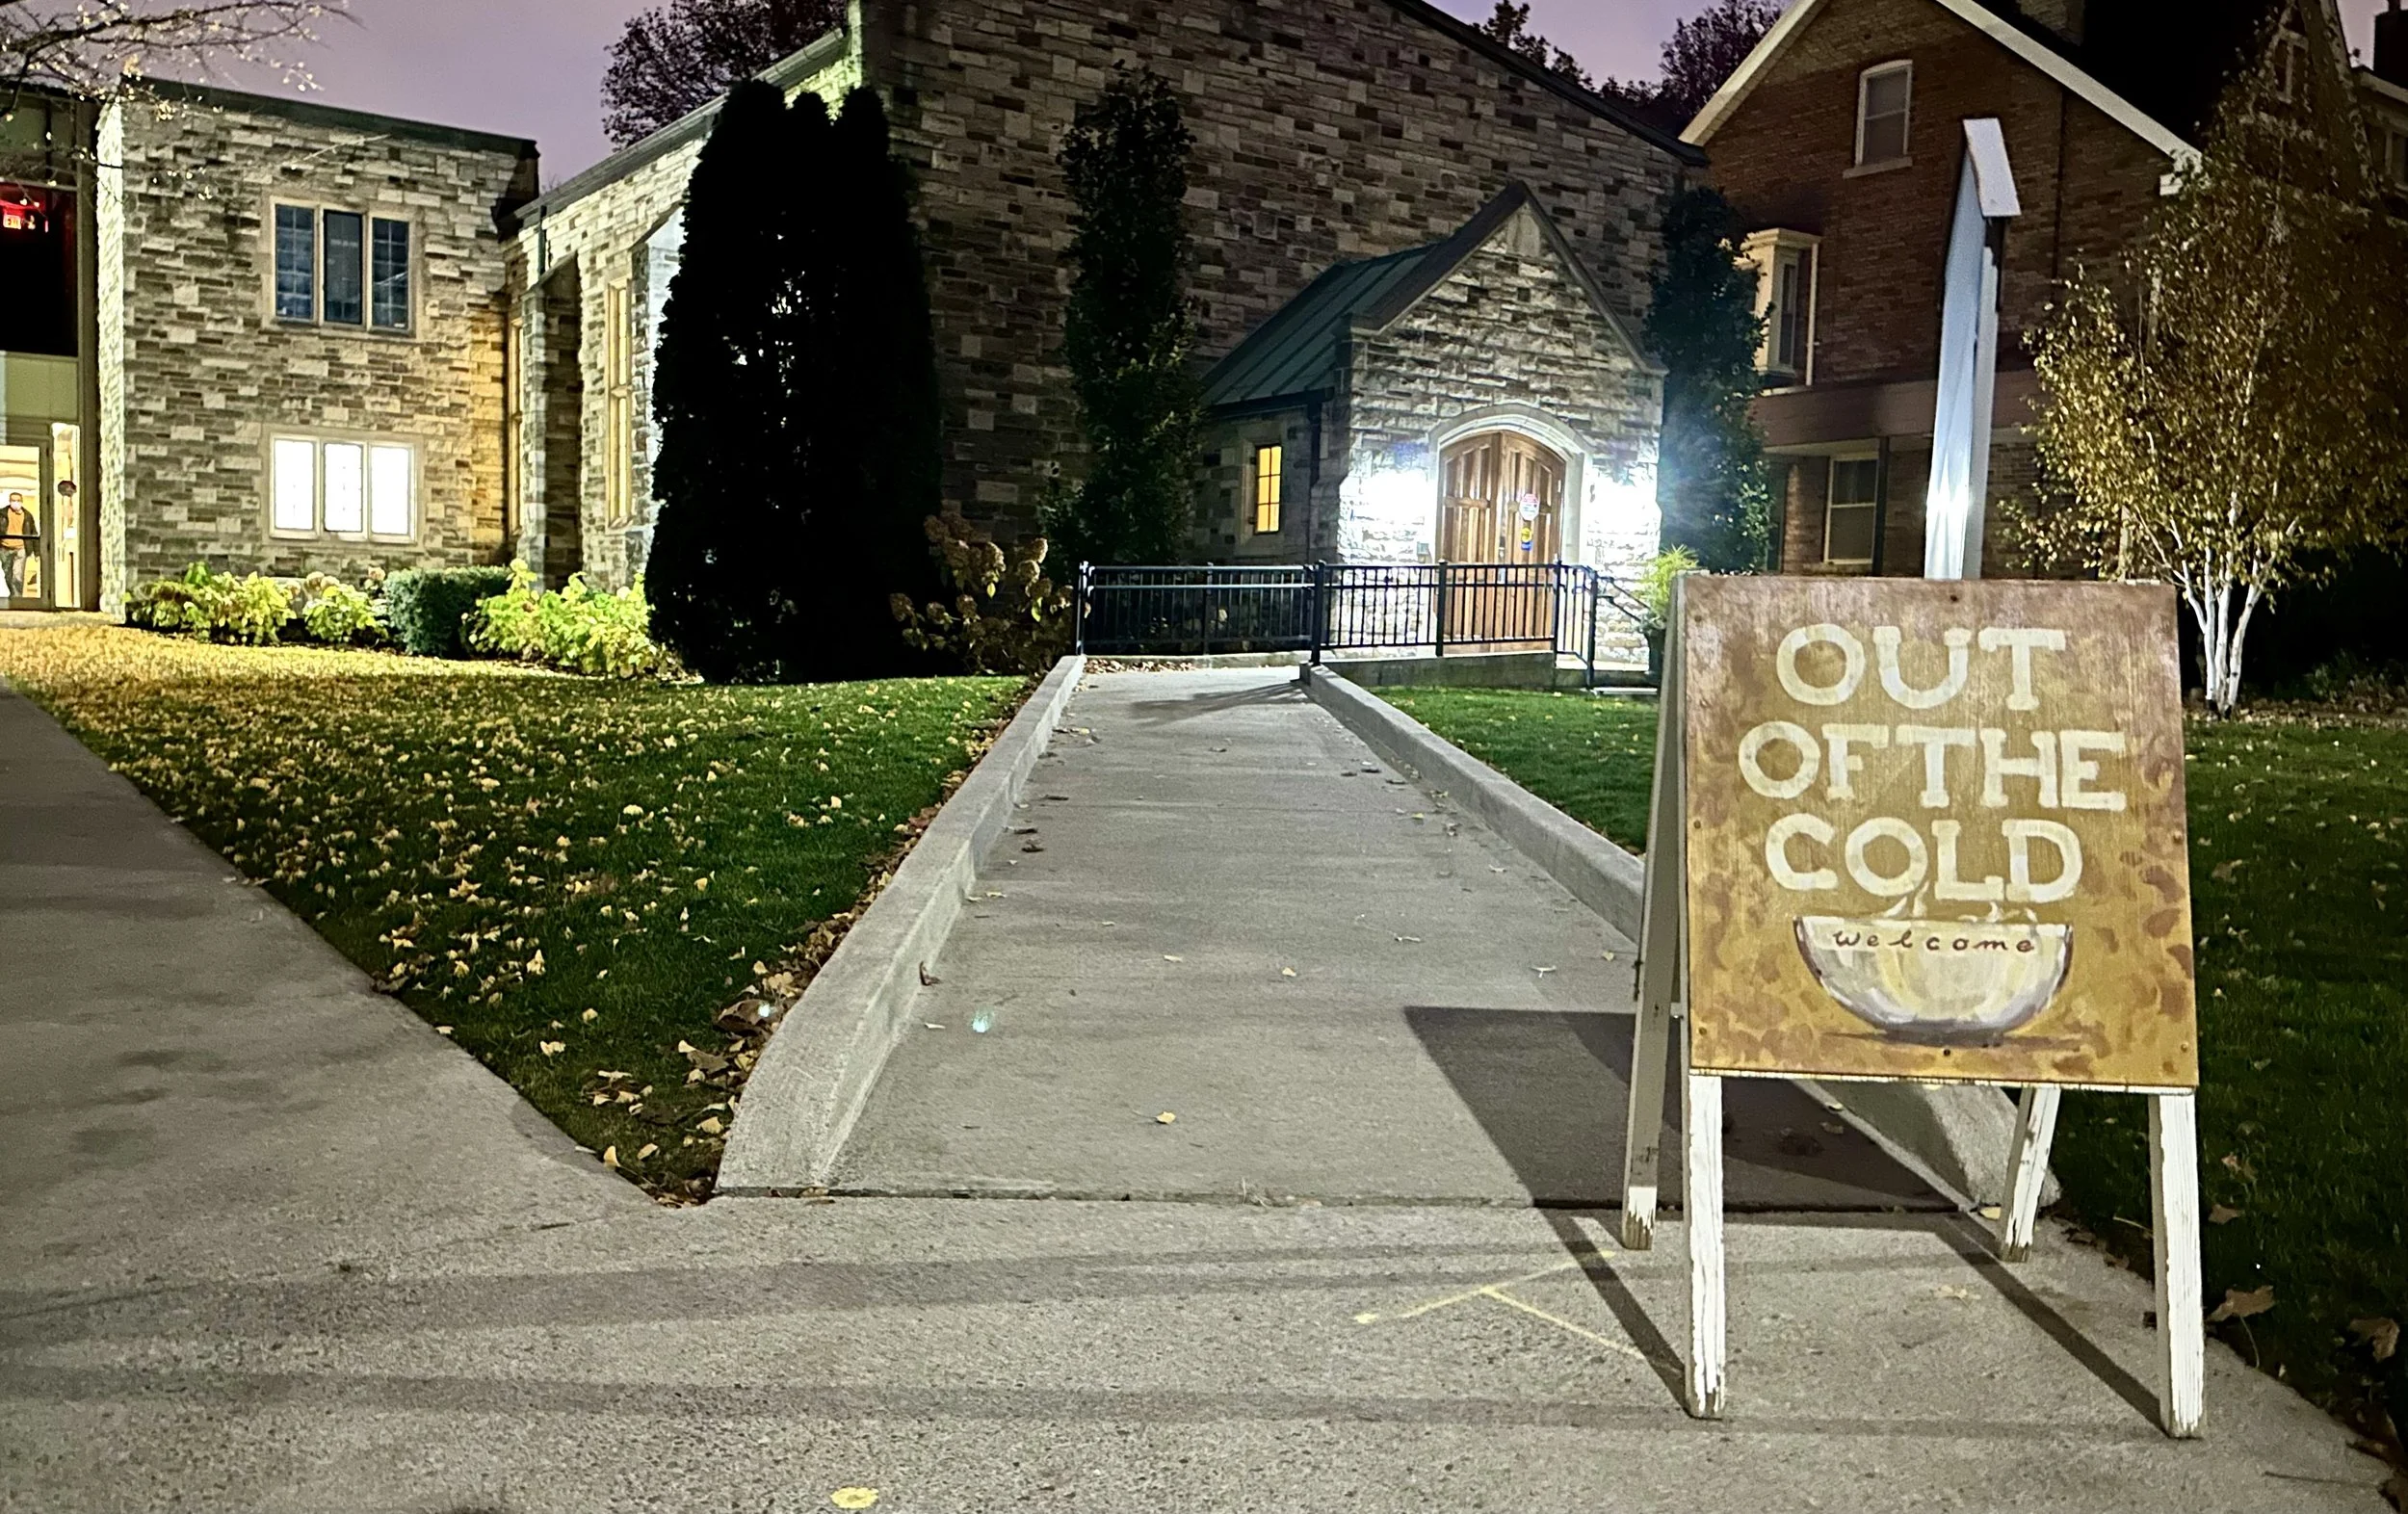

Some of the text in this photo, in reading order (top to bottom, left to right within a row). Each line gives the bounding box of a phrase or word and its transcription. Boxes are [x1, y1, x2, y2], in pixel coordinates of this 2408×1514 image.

[1776, 623, 2067, 710] OUT
[1739, 720, 2126, 811] OF THE
[1765, 813, 2083, 903] COLD
[1832, 929, 2035, 953] welcome
